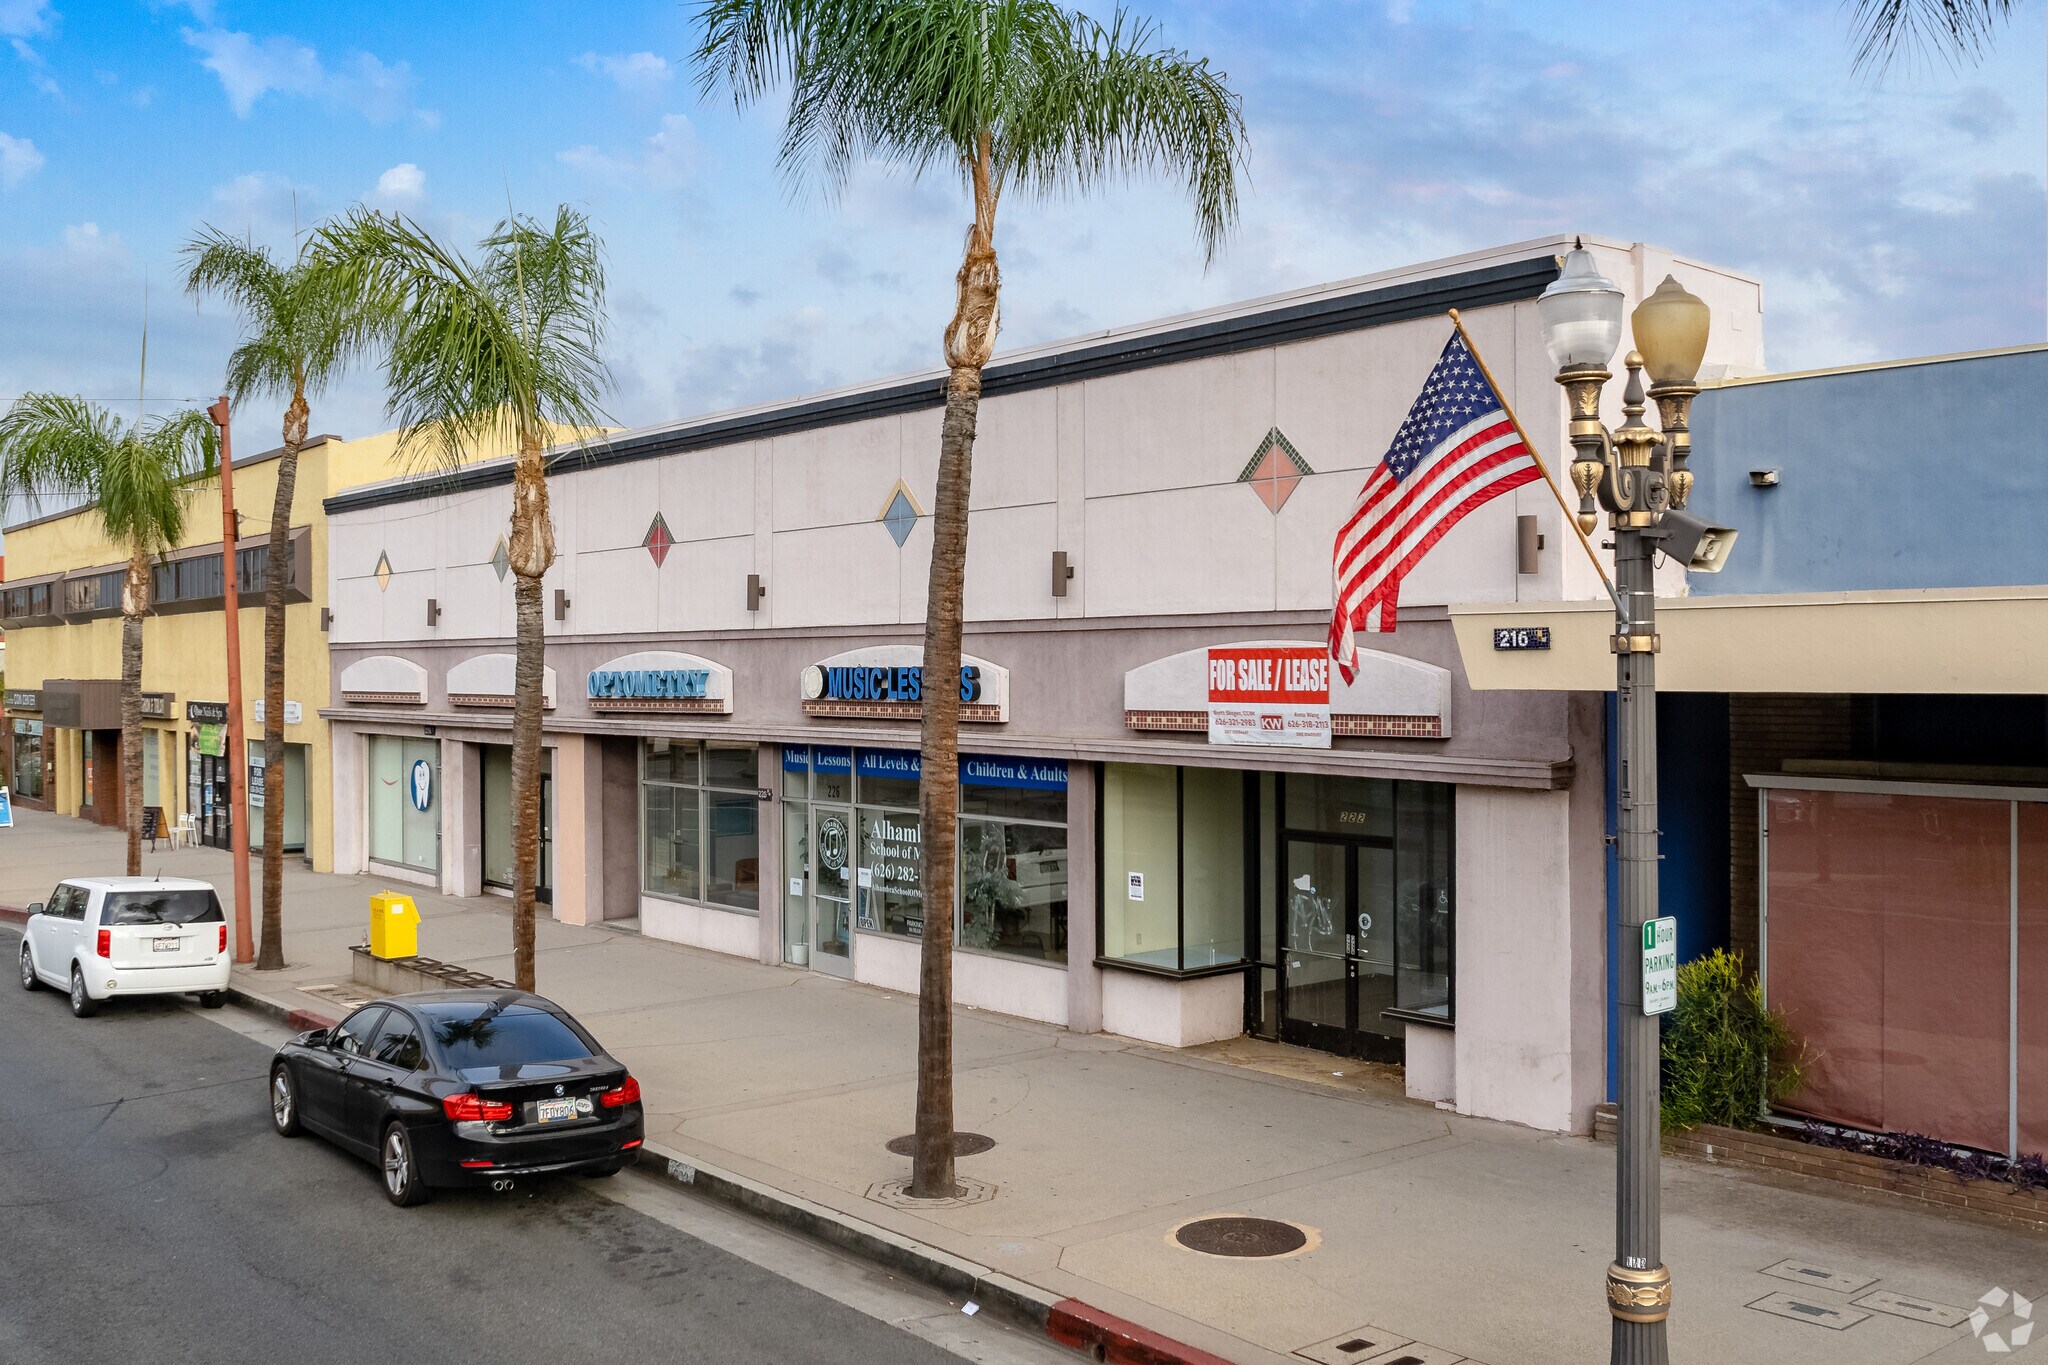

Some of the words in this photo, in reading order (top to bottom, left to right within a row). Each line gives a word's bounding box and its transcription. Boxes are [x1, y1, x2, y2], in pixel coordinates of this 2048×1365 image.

[1499, 630, 1528, 647] 216
[588, 670, 709, 697] OPTOMETRY
[828, 666, 886, 700] MUSIC
[888, 665, 981, 701] LESS
[1209, 659, 1236, 691] FOR
[1238, 659, 1272, 691] SALE
[1274, 659, 1282, 691] /
[1285, 659, 1328, 691] LEASE
[1261, 718, 1283, 730] KW
[1287, 720, 1329, 729] 626-318-2113
[785, 751, 809, 765] Music
[817, 752, 851, 767] Lessons
[862, 755, 877, 768] All
[878, 755, 909, 771] Levels
[910, 760, 920, 772] &
[967, 761, 1014, 779] Children
[1016, 766, 1028, 780] &
[1030, 766, 1068, 783] Adults
[827, 784, 840, 798] 226
[1340, 811, 1366, 824] 222
[871, 819, 921, 843] Alham
[870, 842, 900, 858] School
[901, 847, 911, 860] of
[870, 861, 895, 880] (626)
[1647, 925, 1652, 946] 1
[1656, 927, 1673, 943] HOUR
[1645, 952, 1674, 974] PARKING
